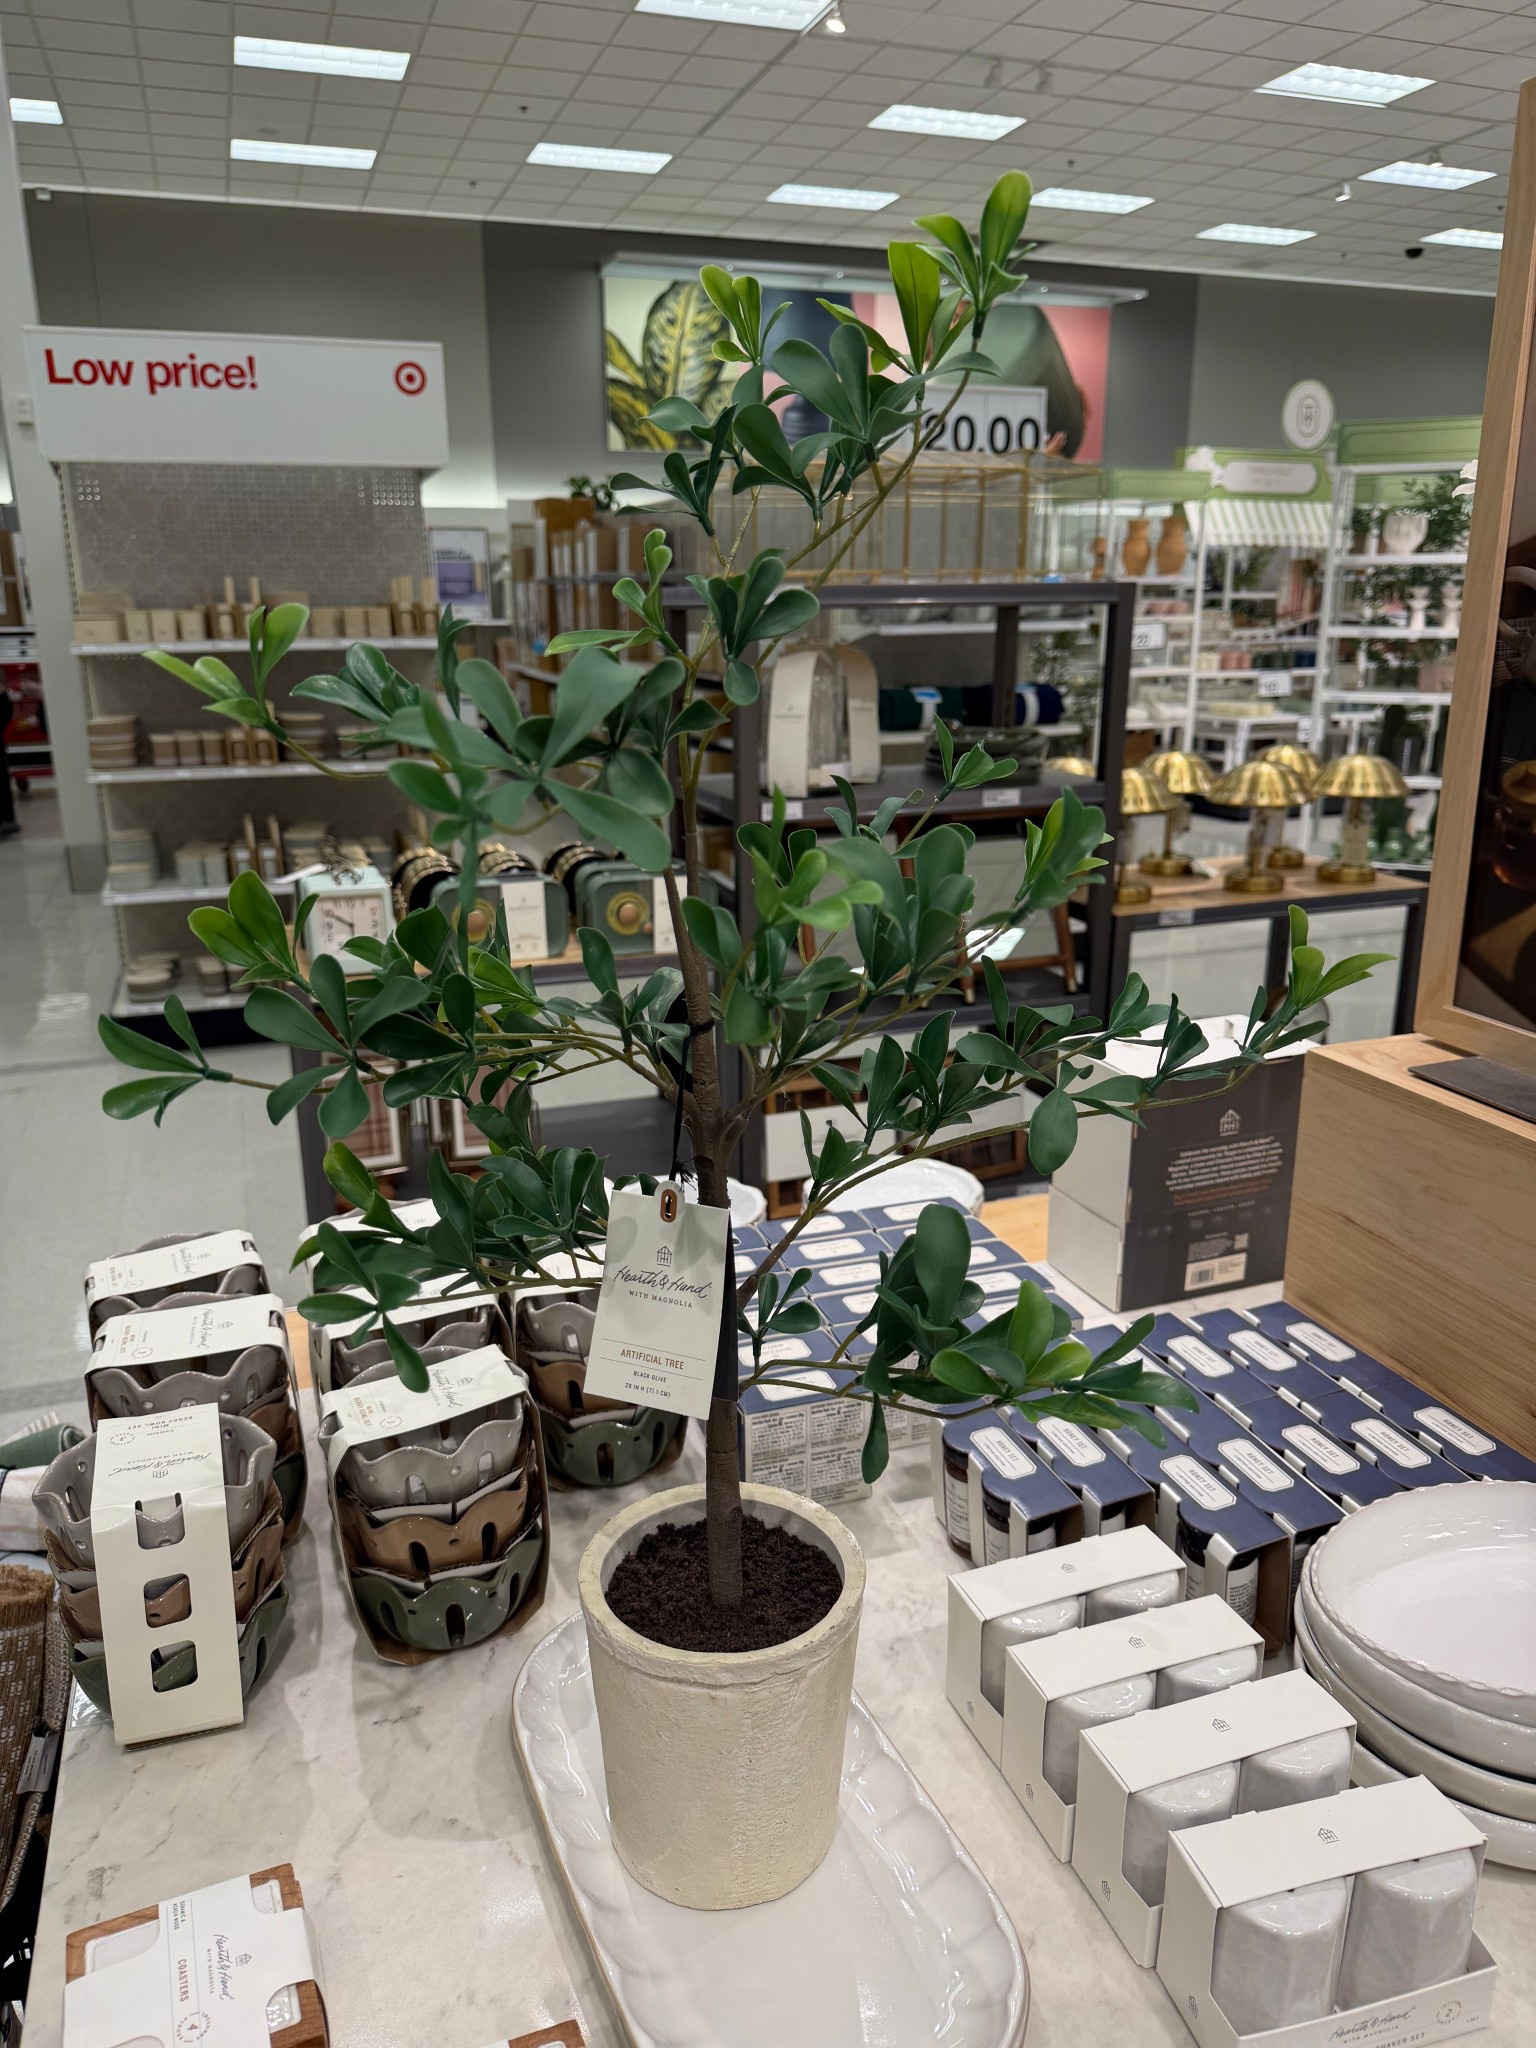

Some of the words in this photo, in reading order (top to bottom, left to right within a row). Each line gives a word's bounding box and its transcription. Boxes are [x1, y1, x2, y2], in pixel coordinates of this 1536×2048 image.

[44, 348, 134, 386] Low
[145, 353, 258, 396] price!
[614, 1266, 663, 1288] Hearth
[660, 1274, 669, 1290] &
[629, 1290, 649, 1299] WITH
[652, 1296, 692, 1308] MAGNOLIA
[620, 1349, 662, 1366] ARTIFICIAL
[665, 1358, 685, 1370] TREE
[634, 1371, 650, 1379] BLACK
[651, 1374, 666, 1382] OLIVE
[1443, 1418, 1461, 1431] HONEY
[1310, 1436, 1327, 1450] HONEY
[1380, 1431, 1398, 1444] HONEY
[1246, 1452, 1264, 1466] HONEY
[1188, 1469, 1206, 1484] HONEY
[214, 1934, 233, 1966] Hearth
[178, 1958, 189, 2002] COASTERS
[220, 1970, 235, 2001] Hand
[187, 2023, 198, 2031] 4
[1343, 2035, 1361, 2044] WITH
[1364, 2025, 1399, 2038] MAGNOLIA
[1410, 2032, 1426, 2042] SET
